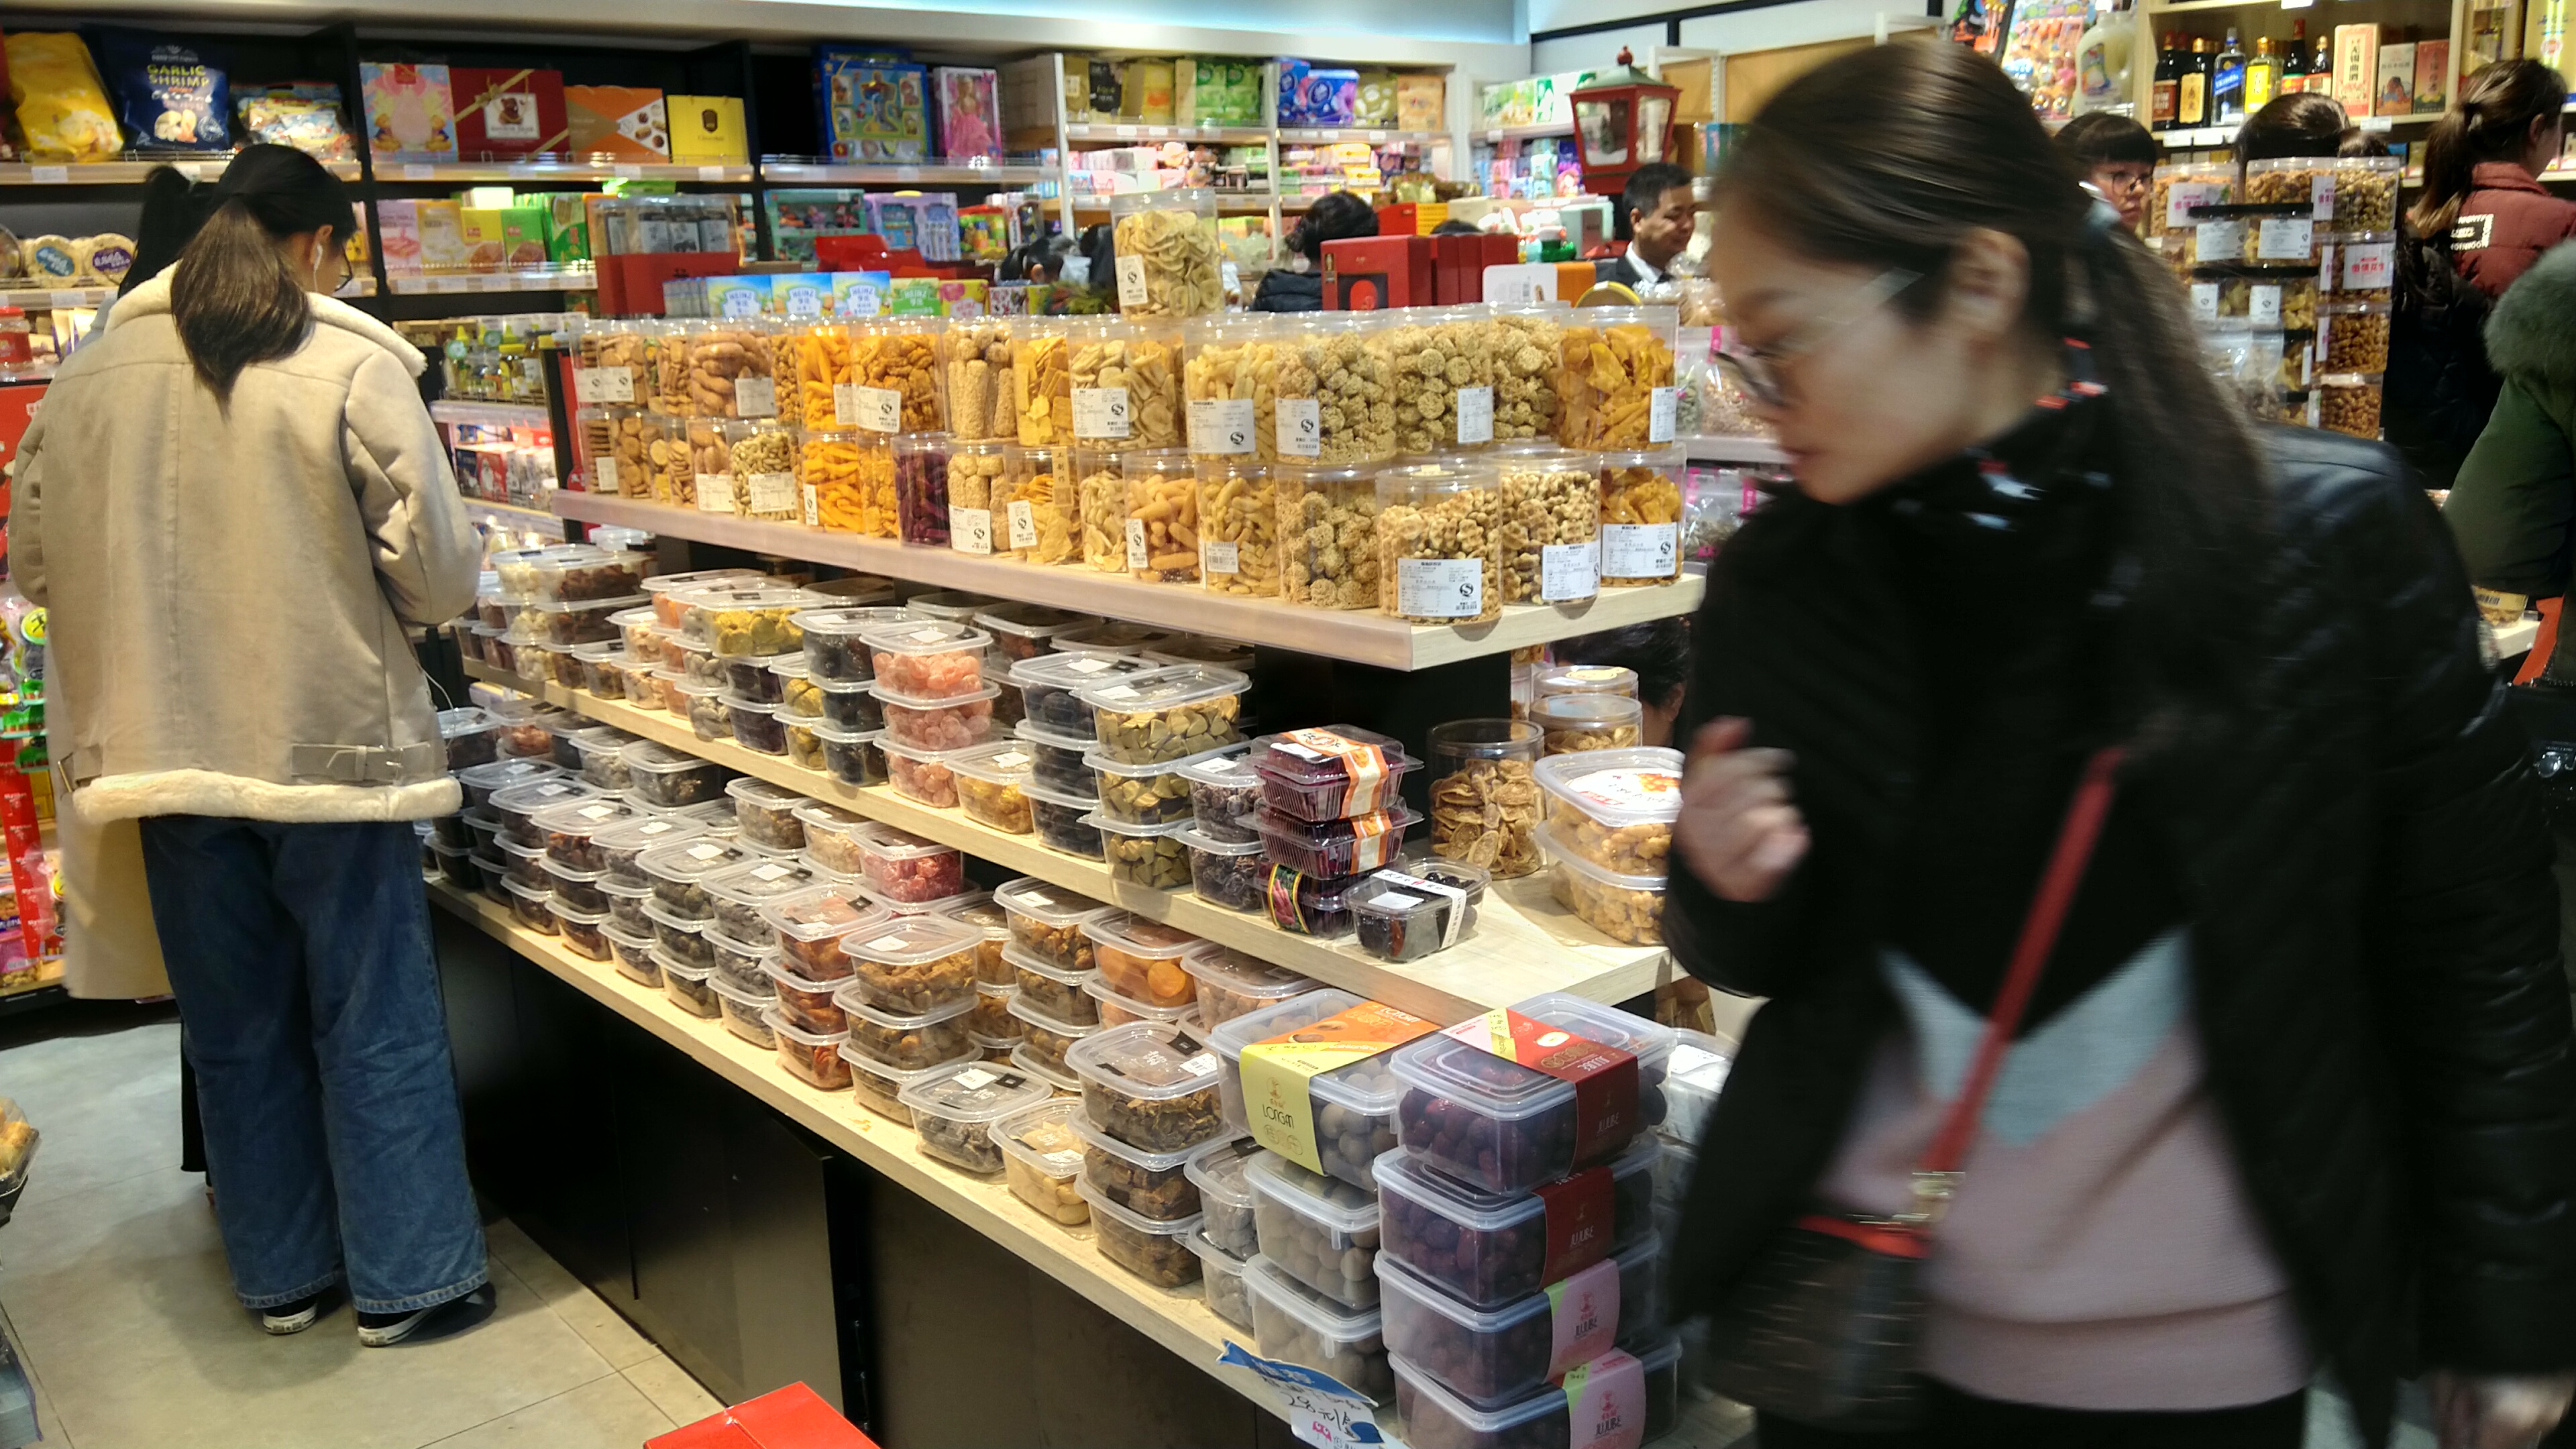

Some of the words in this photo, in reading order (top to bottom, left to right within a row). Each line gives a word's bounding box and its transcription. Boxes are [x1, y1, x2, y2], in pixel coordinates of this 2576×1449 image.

[147, 64, 205, 76] GARLIC
[149, 74, 209, 87] SHRIMP
[729, 290, 752, 301] HEINZ
[792, 289, 815, 299] HEINZ
[851, 287, 873, 297] HEINZ
[906, 289, 926, 299] HEINZ
[1262, 1104, 1294, 1129] LONGAN
[1570, 1225, 1595, 1248] JUJUBE
[1576, 1316, 1598, 1338] JUJUBE
[1596, 1415, 1622, 1436] JUJUBE
